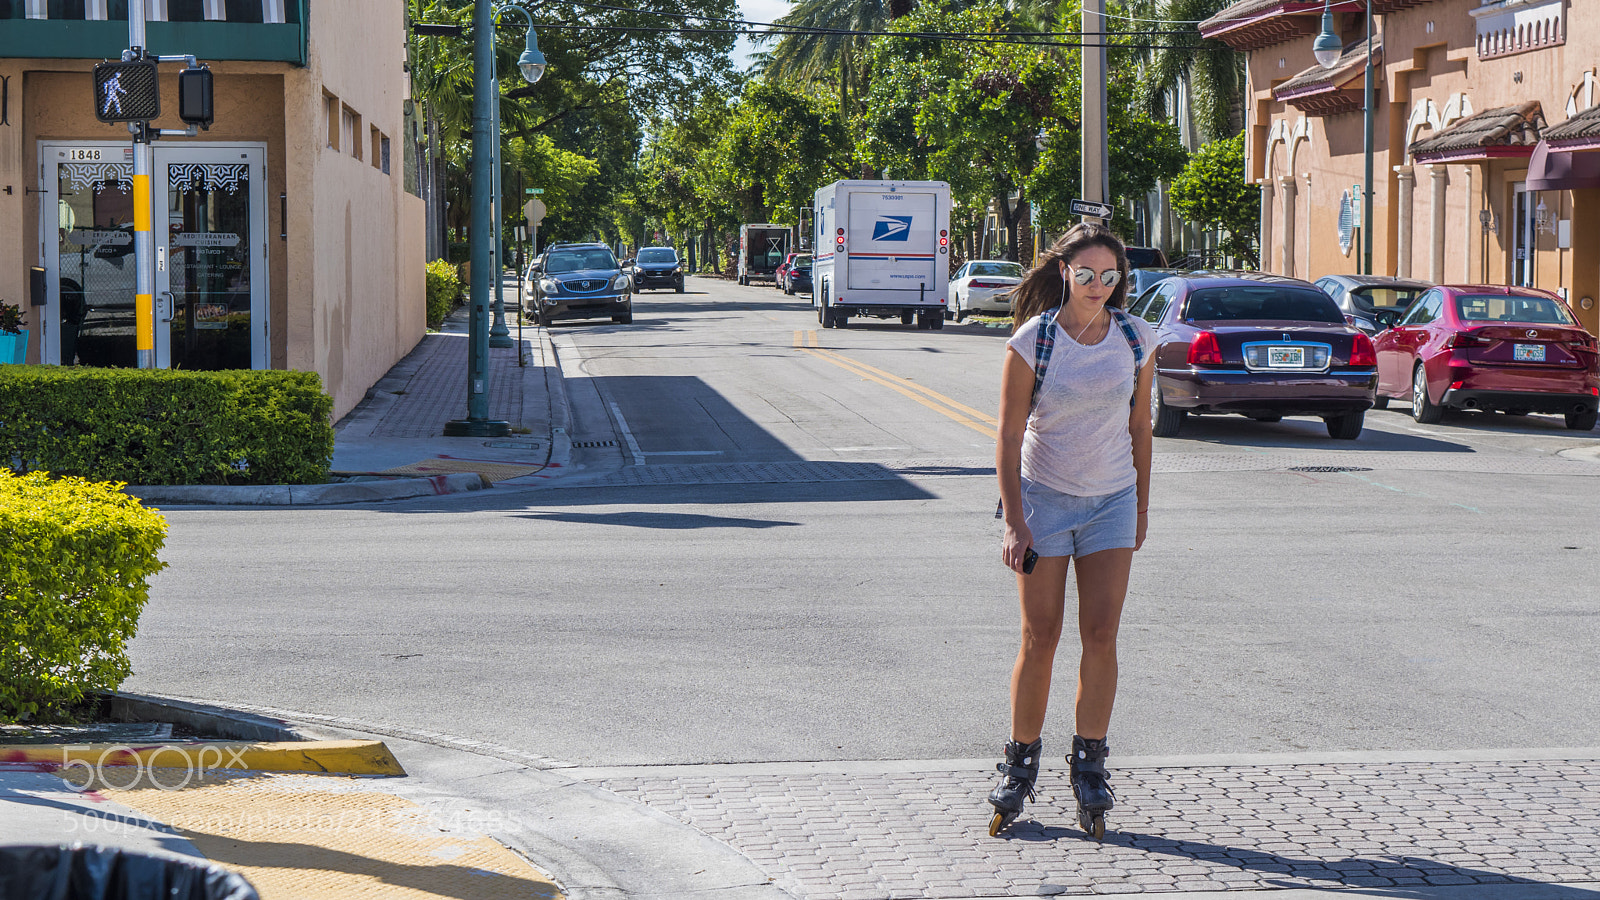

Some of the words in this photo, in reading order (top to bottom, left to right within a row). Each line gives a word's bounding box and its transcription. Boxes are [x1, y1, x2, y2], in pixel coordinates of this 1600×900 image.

[71, 149, 101, 160] 1848
[1074, 204, 1087, 212] ONE
[1088, 206, 1100, 214] WAY
